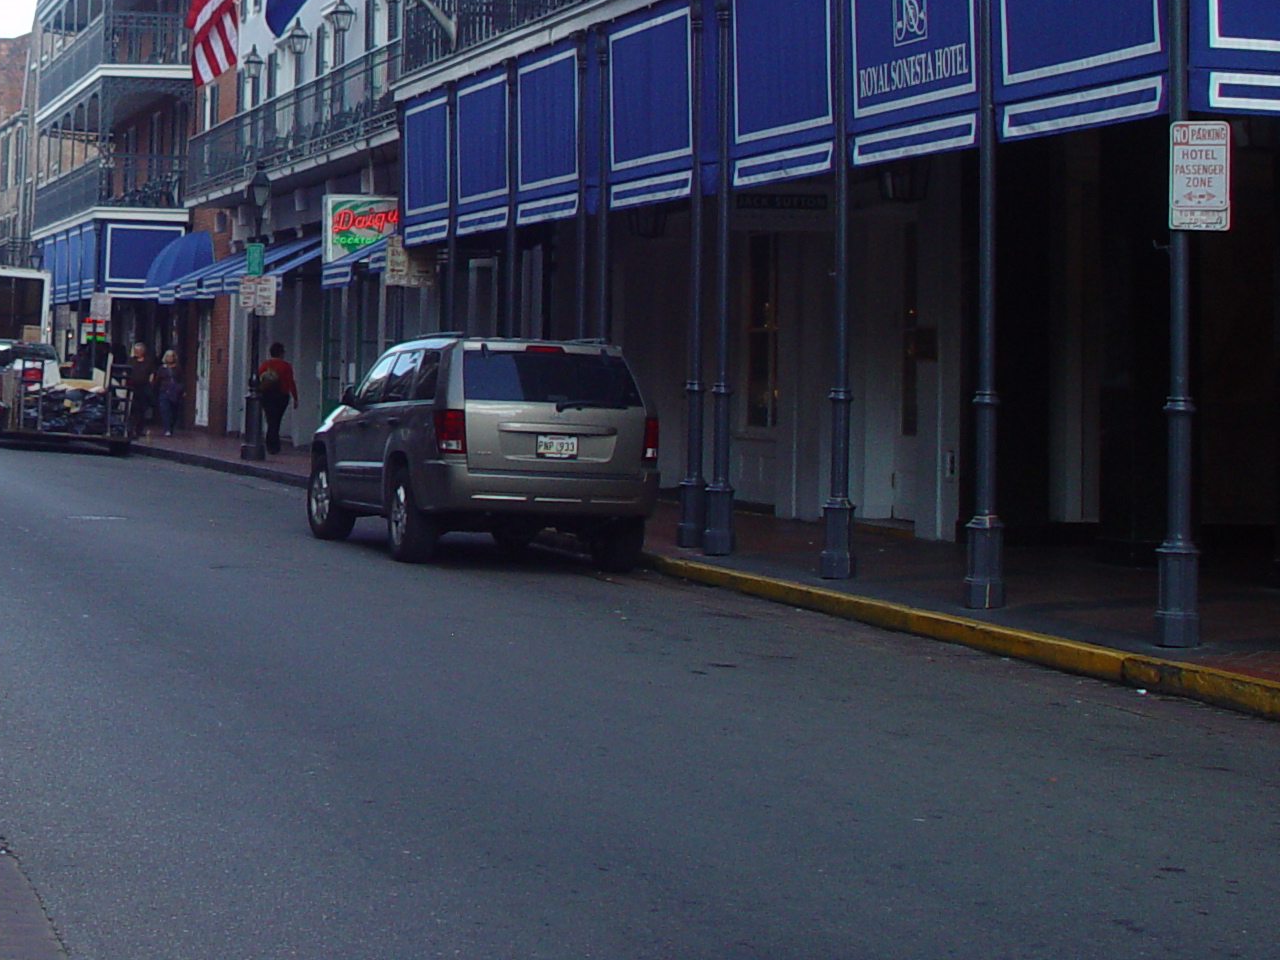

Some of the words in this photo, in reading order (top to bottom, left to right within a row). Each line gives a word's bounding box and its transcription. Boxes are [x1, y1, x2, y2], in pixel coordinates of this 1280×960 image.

[859, 63, 891, 99] ROYAL
[890, 50, 934, 91] SONESTA
[935, 42, 969, 80] HOTEL
[1173, 126, 1189, 144] NO
[1191, 127, 1227, 141] PARKING
[1181, 149, 1218, 160] HOTEL
[1175, 164, 1225, 175] PASSENGER
[1185, 176, 1214, 188] ZONE
[332, 207, 399, 233] Daiqu
